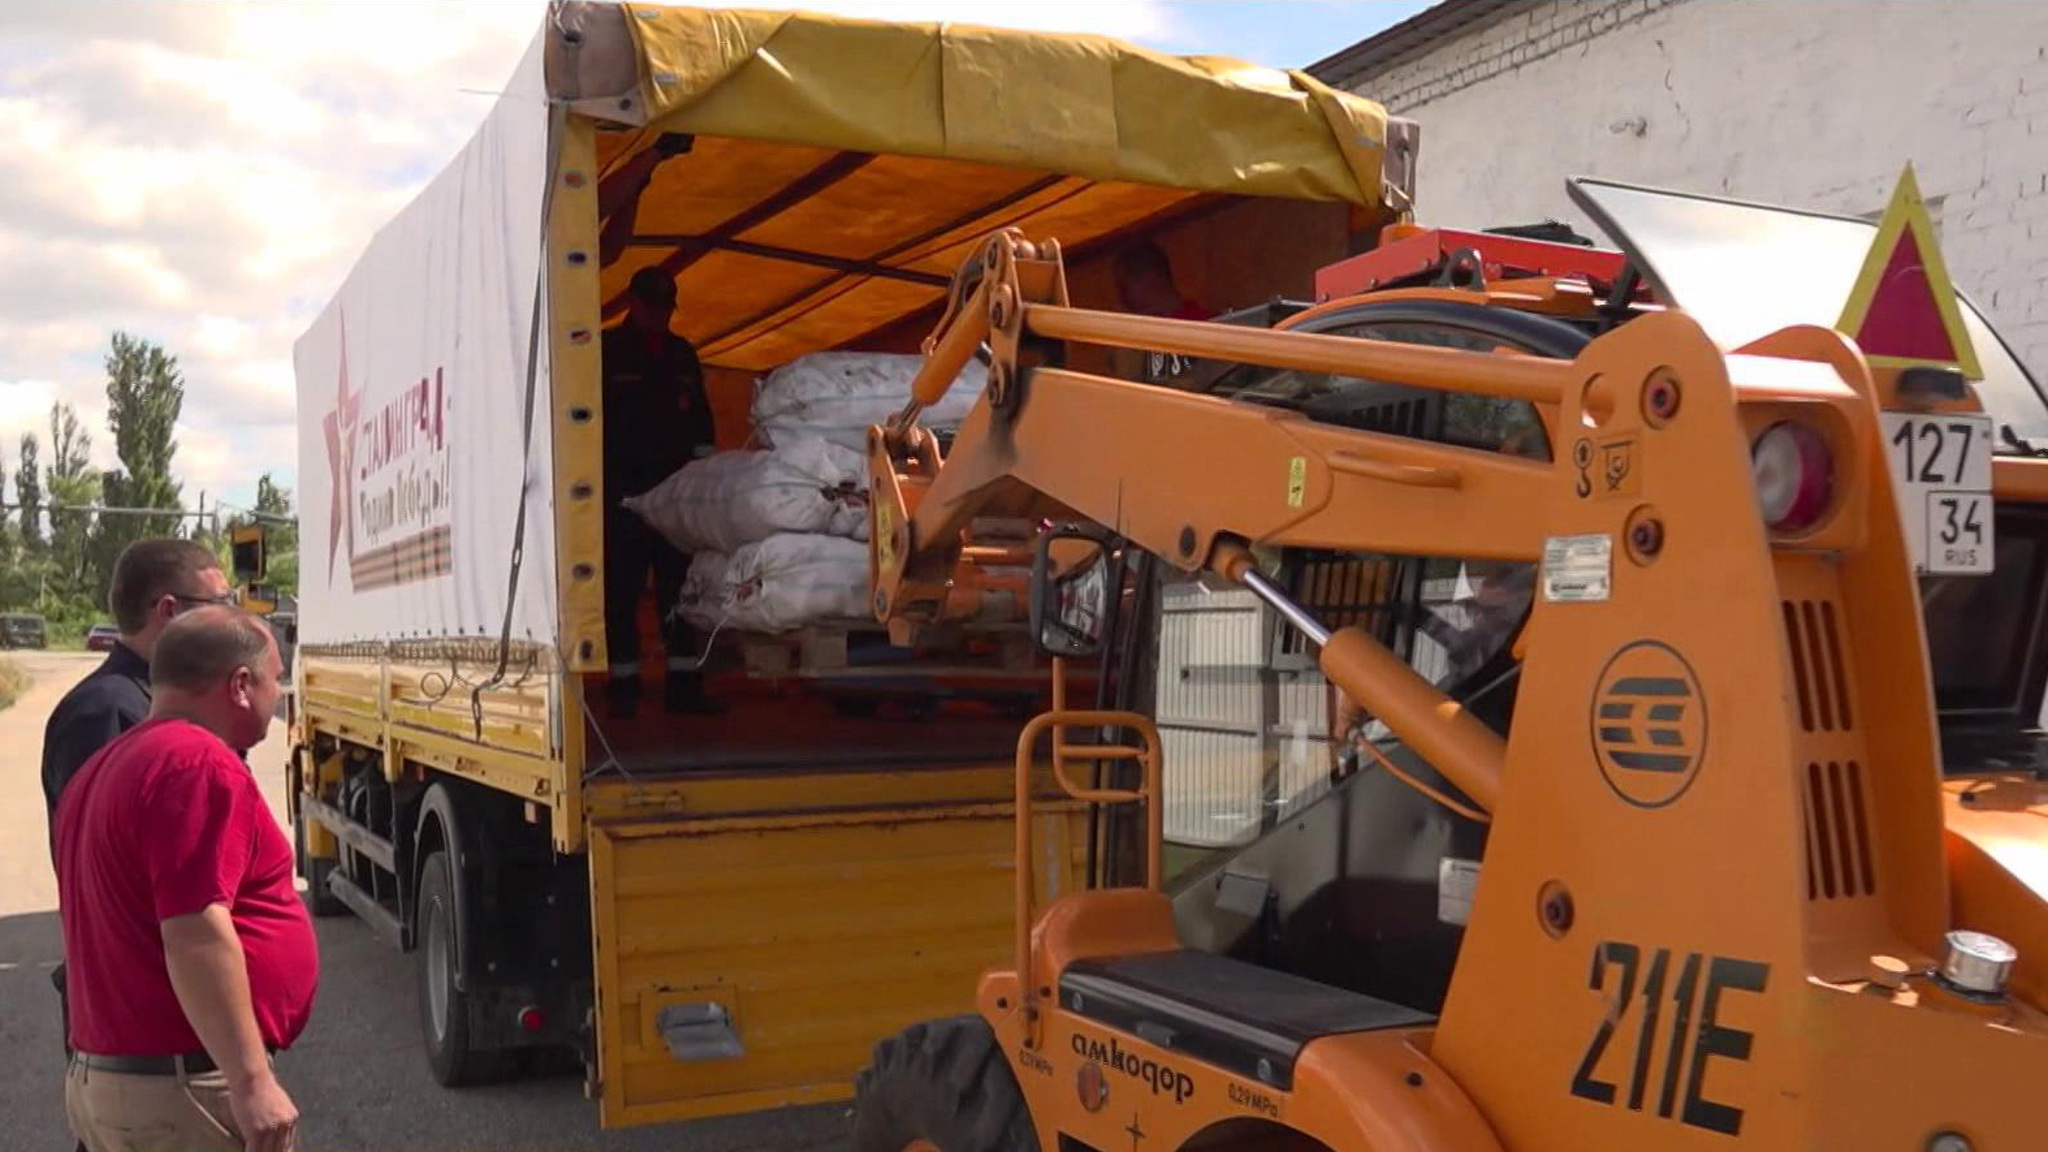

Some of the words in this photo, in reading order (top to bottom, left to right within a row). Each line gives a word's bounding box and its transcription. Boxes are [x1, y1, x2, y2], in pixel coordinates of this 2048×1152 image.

[1893, 420, 1973, 484] 127
[1940, 499, 1982, 544] 34
[1945, 550, 1977, 566] RUS
[1571, 941, 1771, 1137] 211E
